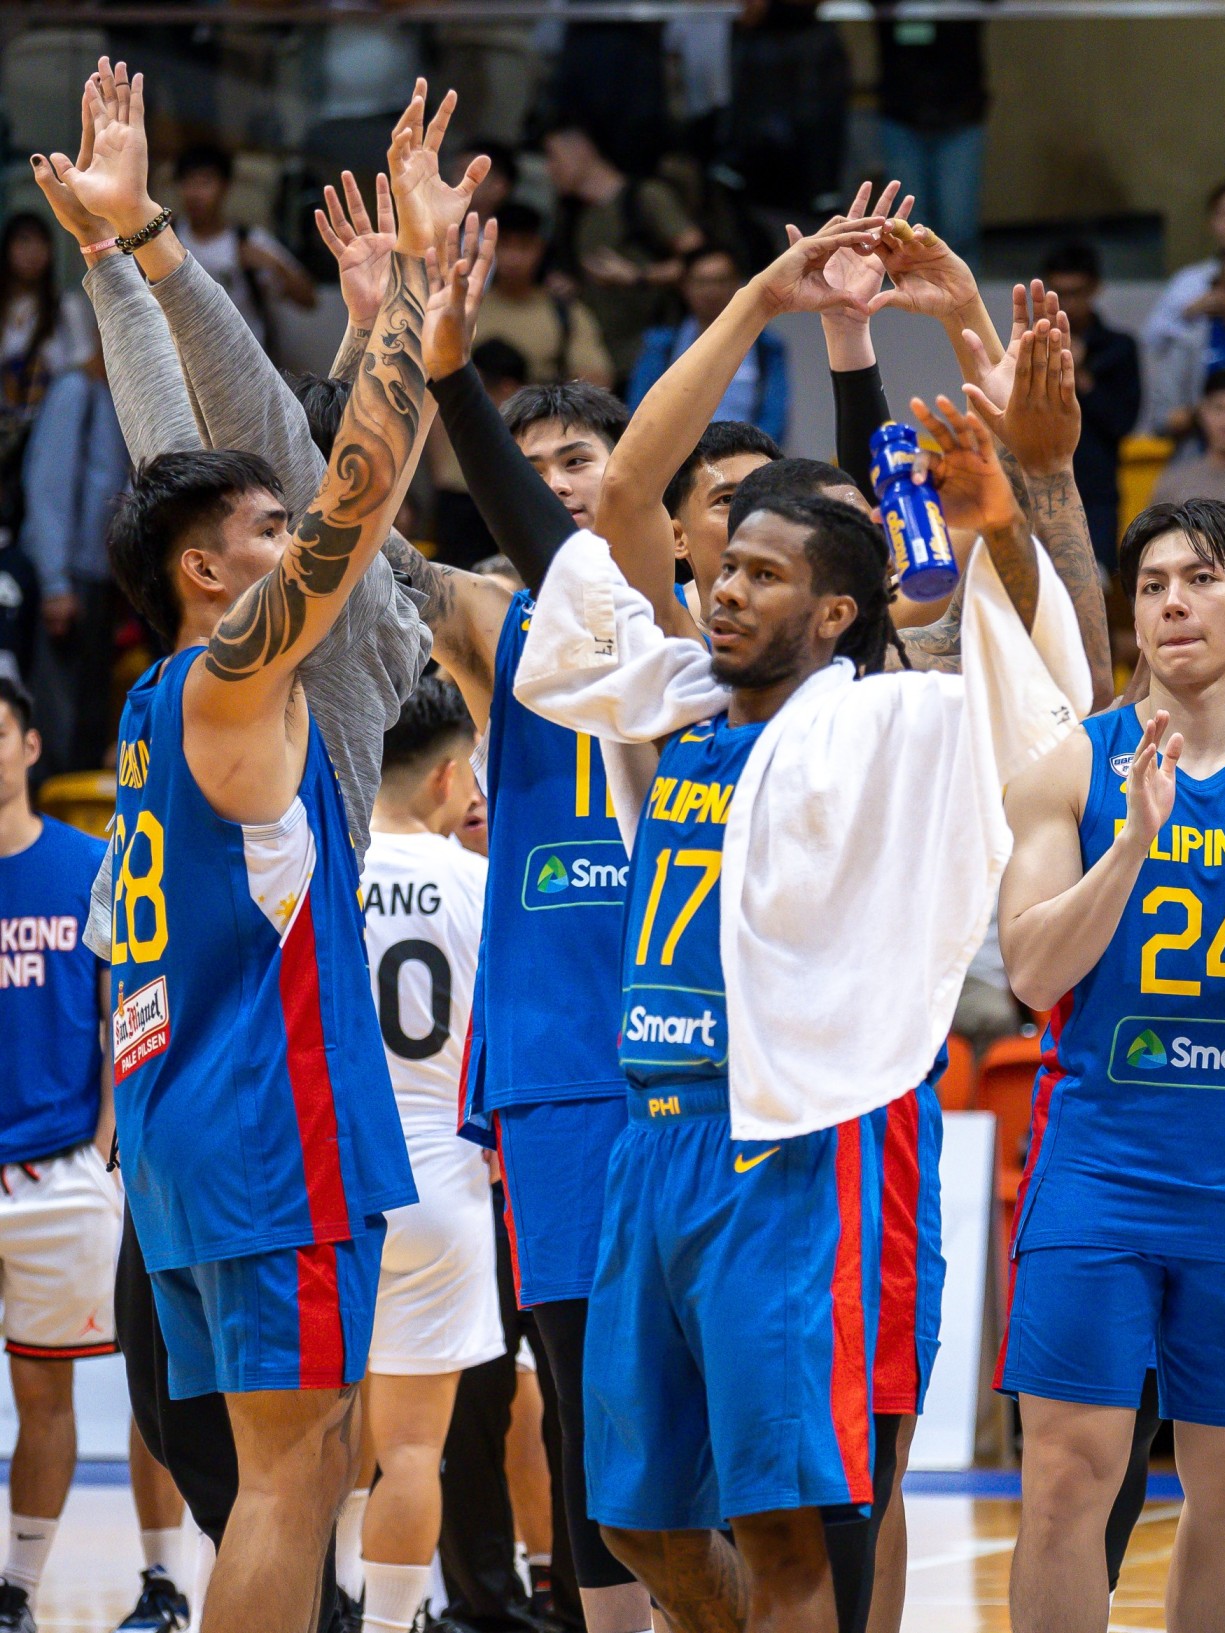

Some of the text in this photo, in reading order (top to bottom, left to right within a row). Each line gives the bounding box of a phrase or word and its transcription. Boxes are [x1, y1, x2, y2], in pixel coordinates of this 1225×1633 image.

[112, 810, 169, 965] 28
[635, 848, 724, 966] 17
[0, 917, 78, 952] KONG
[127, 989, 163, 1040] Miguel
[379, 939, 452, 1062] 0
[627, 1005, 717, 1046] Smart
[121, 1032, 166, 1073] PALE PILSEN
[649, 1096, 680, 1117] PHI
